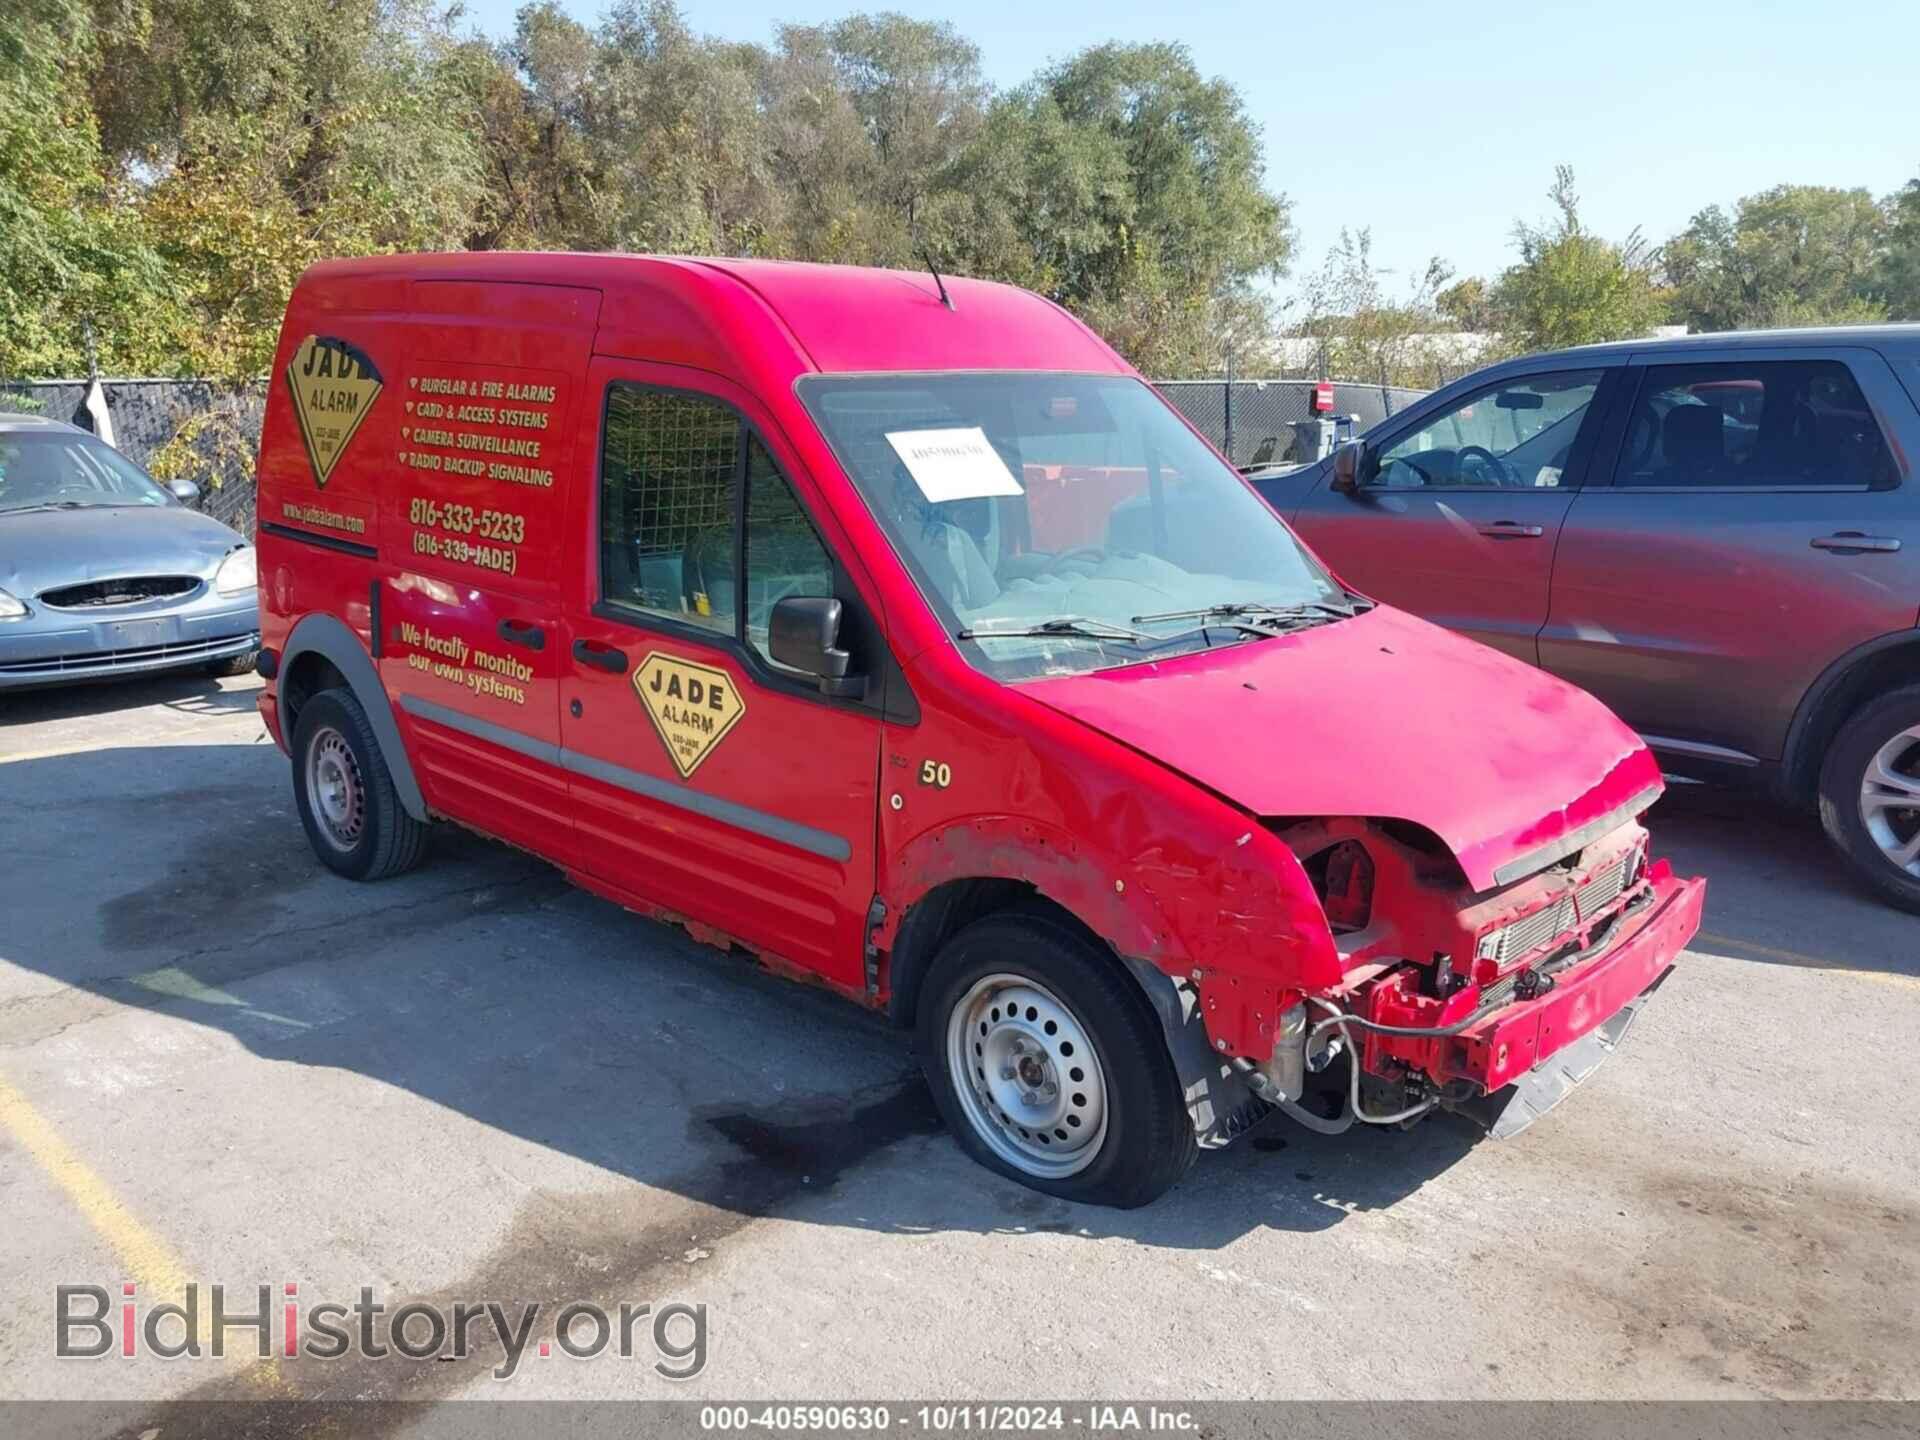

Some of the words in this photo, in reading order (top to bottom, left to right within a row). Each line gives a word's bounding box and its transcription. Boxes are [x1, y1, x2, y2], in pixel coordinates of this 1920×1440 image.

[310, 388, 359, 415] ALARM
[420, 378, 467, 396] BURGLAR
[469, 381, 477, 396] &
[481, 382, 503, 399] FIRE
[506, 384, 556, 403] ALARMS
[416, 402, 444, 418] CARD
[446, 405, 454, 419] &
[457, 406, 495, 424] ACCESS
[498, 408, 549, 429] SYSTEMS
[413, 428, 454, 448] CAMERA
[456, 433, 541, 458] SURVEILLANCE
[408, 452, 441, 470] RADIO
[444, 457, 486, 477] BACKUP
[488, 463, 553, 487] SIGNALING
[282, 502, 365, 535] www.jadealarm.com
[410, 497, 525, 543] 816-333-5233
[413, 530, 517, 576] (816-333-JADE)
[400, 621, 421, 647] We
[424, 628, 469, 666] locally
[474, 649, 534, 683] monitor
[408, 652, 431, 671] our
[434, 662, 463, 684] own
[467, 671, 525, 705] systems
[650, 668, 724, 711] JADE
[662, 703, 715, 735] ALARM
[922, 759, 951, 788] 50
